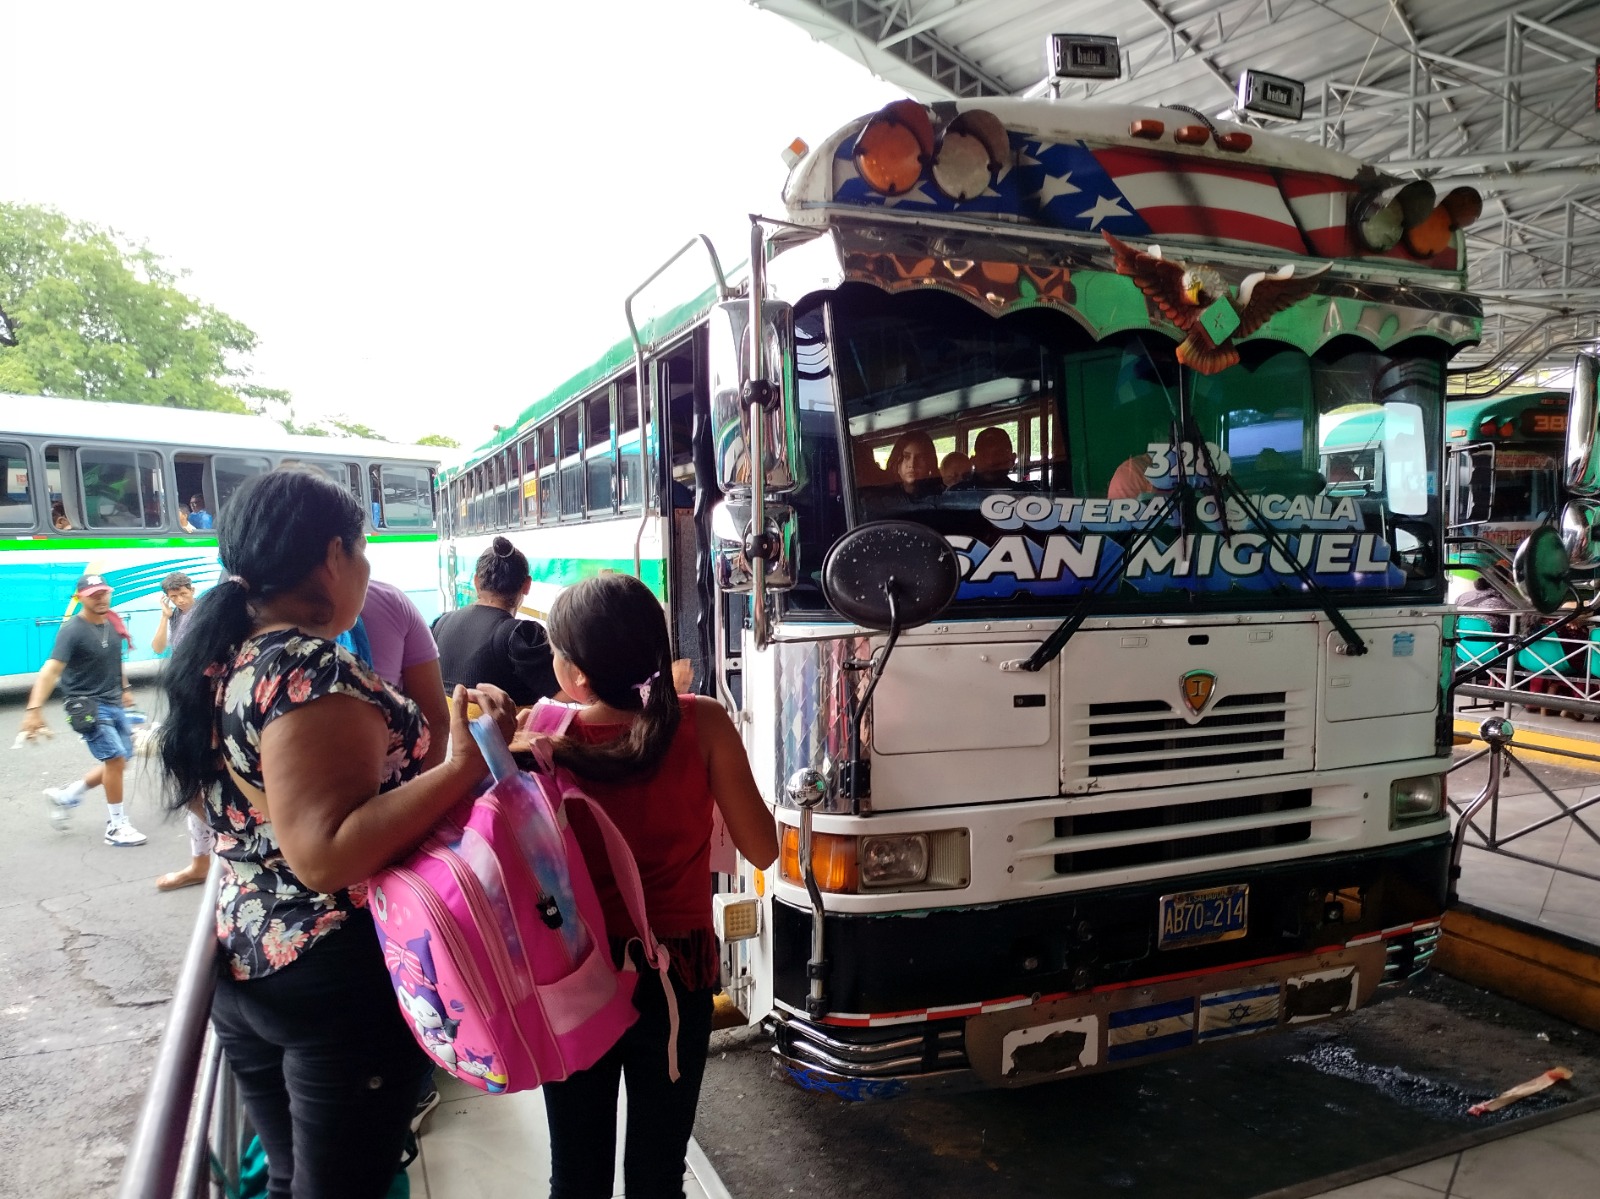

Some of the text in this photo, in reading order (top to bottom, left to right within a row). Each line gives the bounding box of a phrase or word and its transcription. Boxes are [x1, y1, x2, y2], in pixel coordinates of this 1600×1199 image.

[1534, 415, 1567, 432] 38
[1144, 441, 1231, 478] 328
[980, 494, 1357, 523] GOTERA OSICALA
[1126, 533, 1389, 577] MIGUEL
